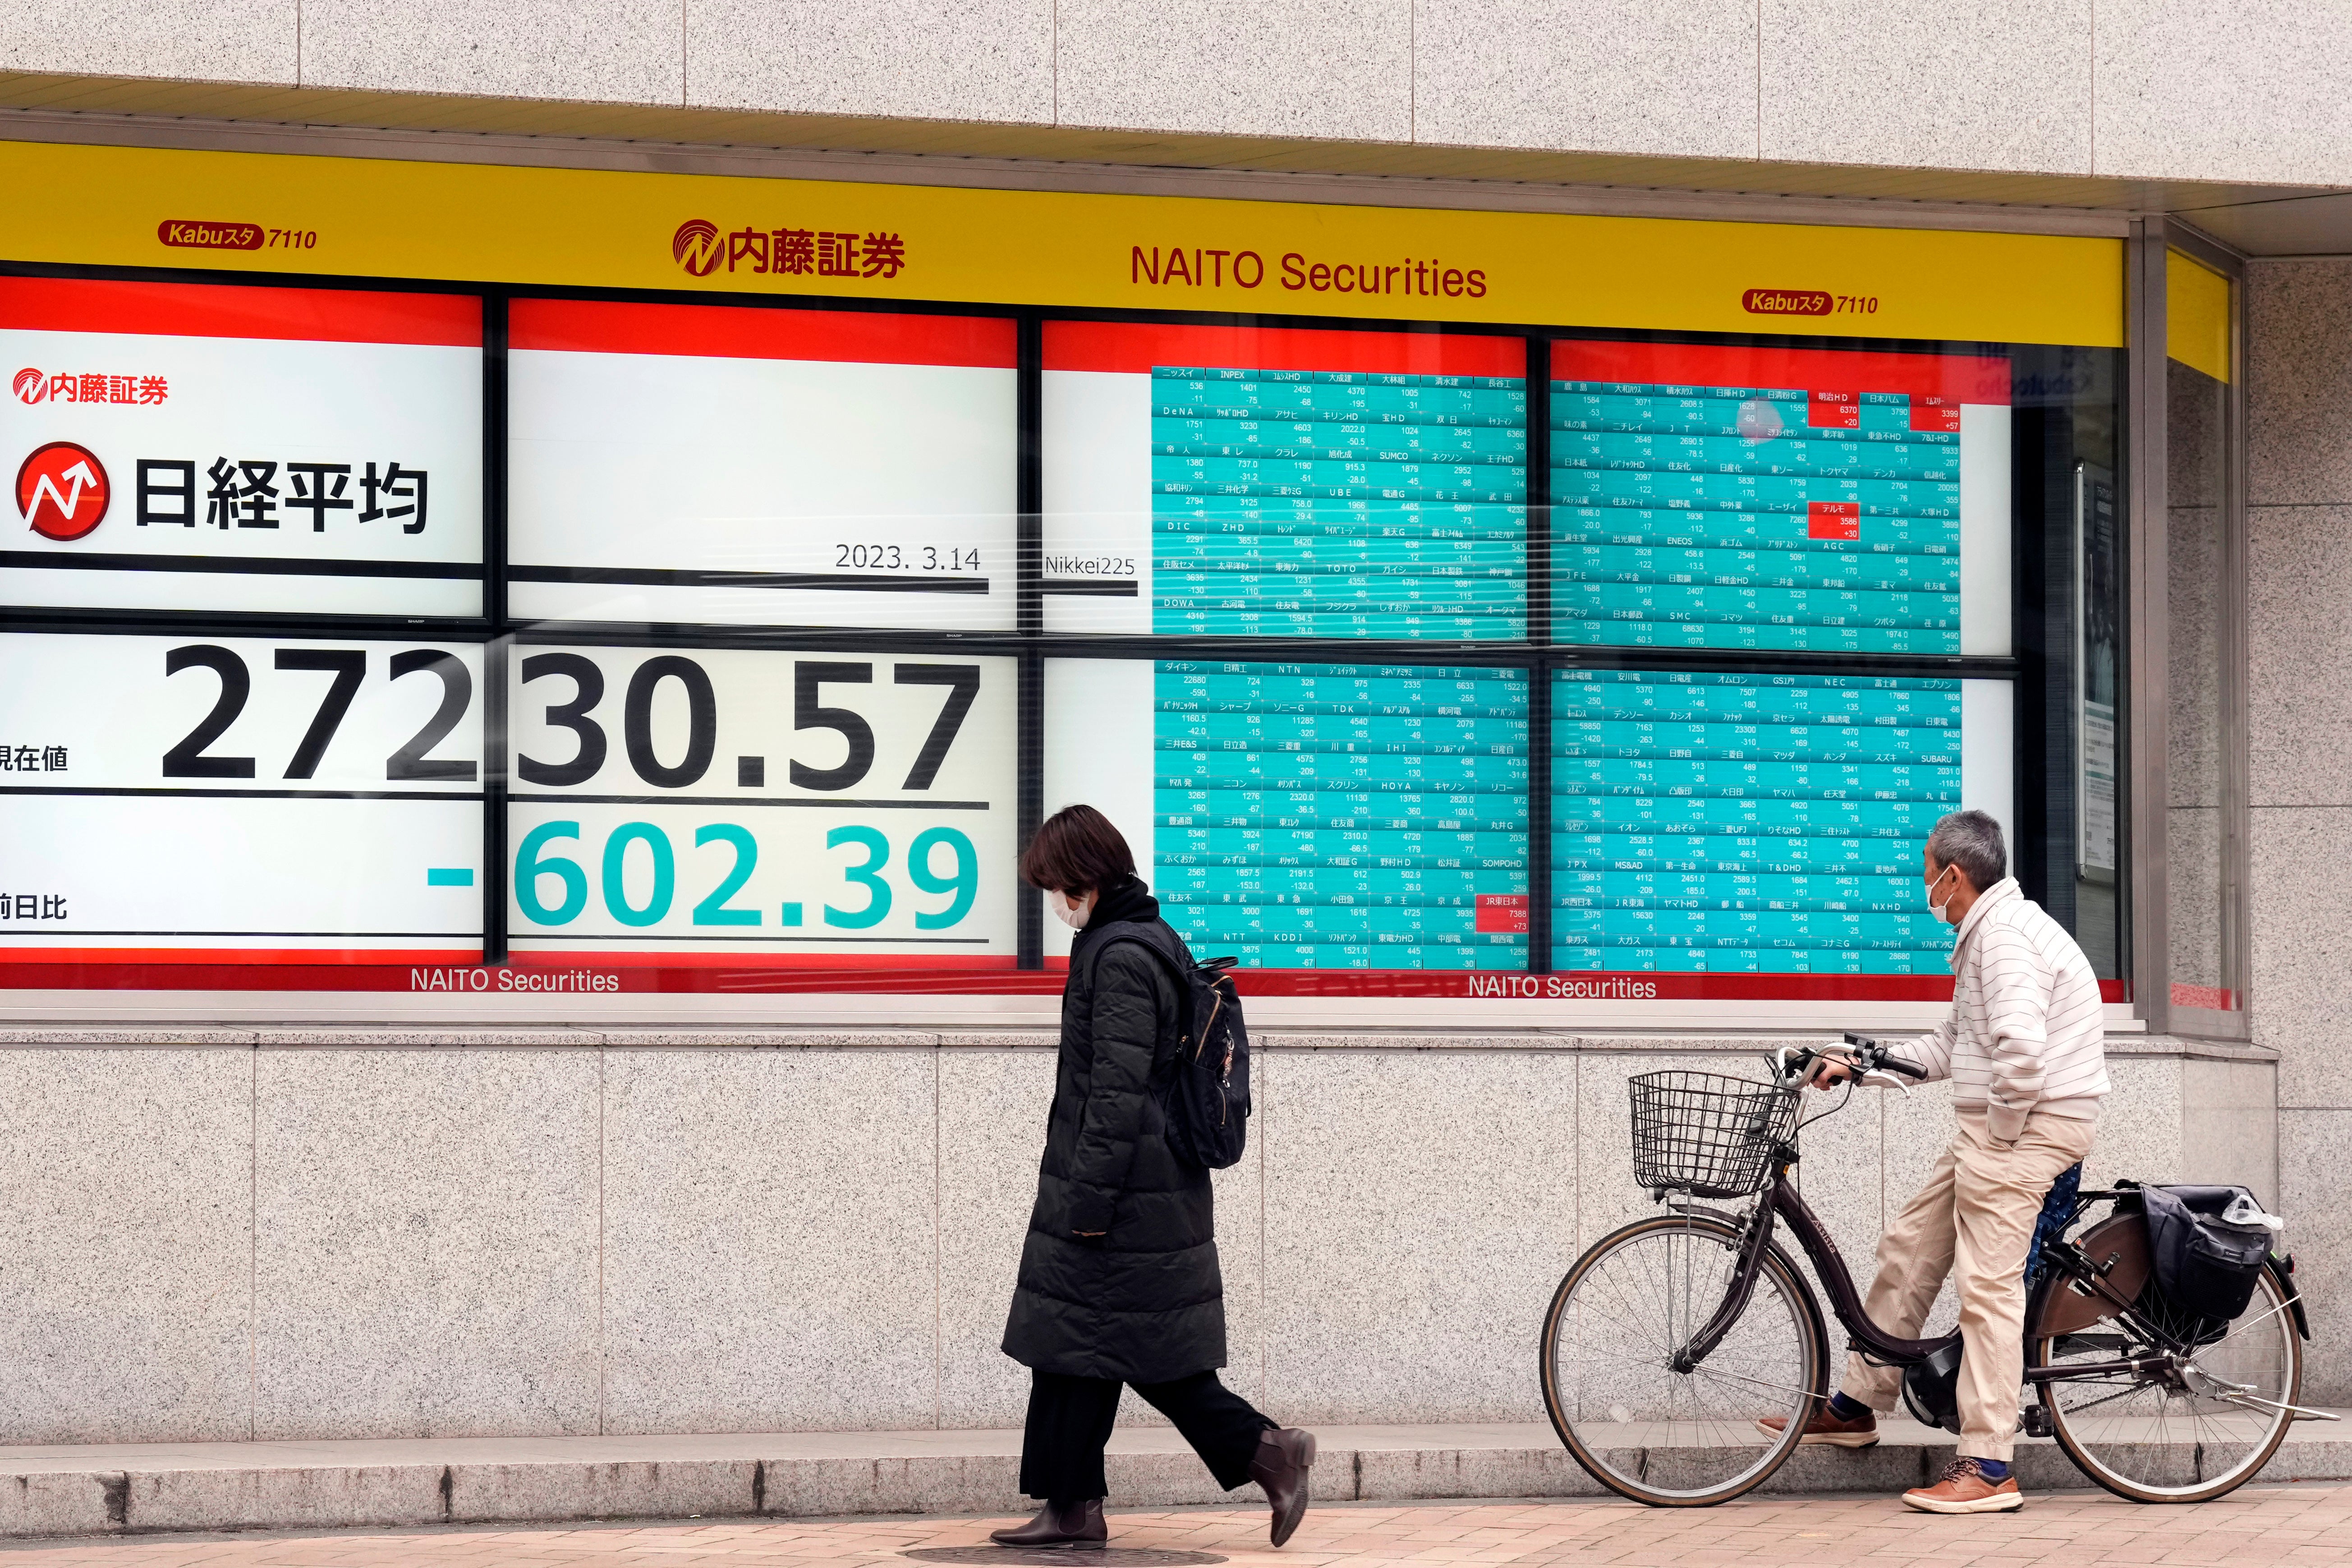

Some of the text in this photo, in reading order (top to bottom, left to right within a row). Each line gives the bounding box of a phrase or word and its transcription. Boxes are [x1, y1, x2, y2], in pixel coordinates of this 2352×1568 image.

[168, 224, 317, 249] Kabuスタ 7110
[728, 226, 905, 279] 内藤証券
[1132, 246, 1487, 298] NAITO Securities
[1751, 292, 1878, 314] Kabuスタ 7110
[1220, 370, 1245, 379] INPEX
[50, 372, 168, 405] 内藤証券
[1240, 383, 1257, 391] 1401
[1401, 389, 1419, 397] 1005
[1246, 396, 1258, 404] -75
[1407, 401, 1418, 409] -31
[1840, 406, 1857, 414] 6370
[1891, 408, 1908, 416] 3790
[1844, 418, 1857, 426] +20
[1897, 421, 1908, 429] -15
[1293, 423, 1312, 432] 4603
[1341, 425, 1365, 433] 2022.0
[1295, 436, 1312, 444] -186
[1347, 437, 1365, 446] -50.5
[1921, 434, 1949, 442] 7&I-HD
[1589, 446, 1600, 454] -36
[1942, 446, 1960, 455] 5933
[1379, 451, 1408, 460] SUMCO
[1294, 461, 1313, 470] 1190
[1943, 459, 1959, 467] -207
[1511, 468, 1525, 476] 529
[1300, 474, 1311, 482] -51
[1407, 477, 1419, 485] -45
[1840, 480, 1858, 488] 2039
[137, 456, 427, 534] 日経平均
[1846, 492, 1858, 501] -90
[1240, 498, 1258, 506] 3125
[1241, 510, 1258, 519] -140
[1840, 517, 1857, 525] 3586
[1844, 529, 1857, 538] +30
[1238, 535, 1259, 545] 365.5
[1667, 537, 1693, 545] ENEOS
[1244, 549, 1259, 557] -4.8
[1684, 550, 1704, 558] 458.6
[1046, 556, 1135, 575] Nikkei225
[1686, 562, 1704, 570] -13.5
[1641, 598, 1652, 606] -66
[1288, 614, 1313, 623] 1594.5
[1294, 626, 1313, 635] -78.0
[1629, 623, 1652, 631] 1118.0
[1682, 625, 1704, 633] 68630
[1635, 635, 1652, 644] -60.5
[1183, 675, 1206, 684] 22680
[1300, 678, 1314, 686] 329
[1190, 688, 1206, 697] -590
[1302, 691, 1315, 699] -16
[1739, 688, 1756, 696] 7507
[1741, 700, 1756, 708] -180
[163, 644, 980, 791] 27230.57
[1350, 717, 1368, 726] 4540
[1635, 723, 1653, 731] 7163
[1351, 730, 1368, 738] -165
[1637, 736, 1653, 744] -263
[1192, 753, 1206, 761] 409
[1921, 755, 1952, 763] SUBARU
[1507, 758, 1527, 767] 473.0
[1630, 761, 1653, 769] 1784.5
[1194, 765, 1206, 774] -22
[1937, 767, 1961, 775] 2031.0
[1509, 771, 1527, 779] -31.6
[1635, 773, 1653, 781] -79.5
[1399, 794, 1421, 803] 13765
[1790, 801, 1808, 809] 4920
[1405, 807, 1421, 815] -360
[1456, 833, 1474, 841] 1885
[1629, 836, 1654, 844] 2528.5
[1462, 846, 1474, 854] -77
[1635, 848, 1654, 857] -60.0
[1483, 859, 1522, 868] SOMPOHD
[1615, 861, 1643, 869] MS&AD
[1236, 867, 1261, 877] 1857.5
[1509, 872, 1526, 880] 5391
[1635, 874, 1653, 882] 4112
[1237, 881, 1261, 890] -153.0
[1511, 884, 1527, 893] -259
[1637, 886, 1654, 894] -209
[1509, 910, 1527, 918] 7388
[1893, 915, 1910, 923] 7640
[1513, 922, 1527, 930] +73
[1895, 927, 1910, 935] -150
[1295, 946, 1314, 954] 4000
[1302, 958, 1314, 967] -67
[1792, 963, 1808, 971] -103
[411, 968, 619, 992] NAITO Securities
[1469, 975, 1656, 998] NAITO Securities
[1812, 1219, 1836, 1254] Assista
